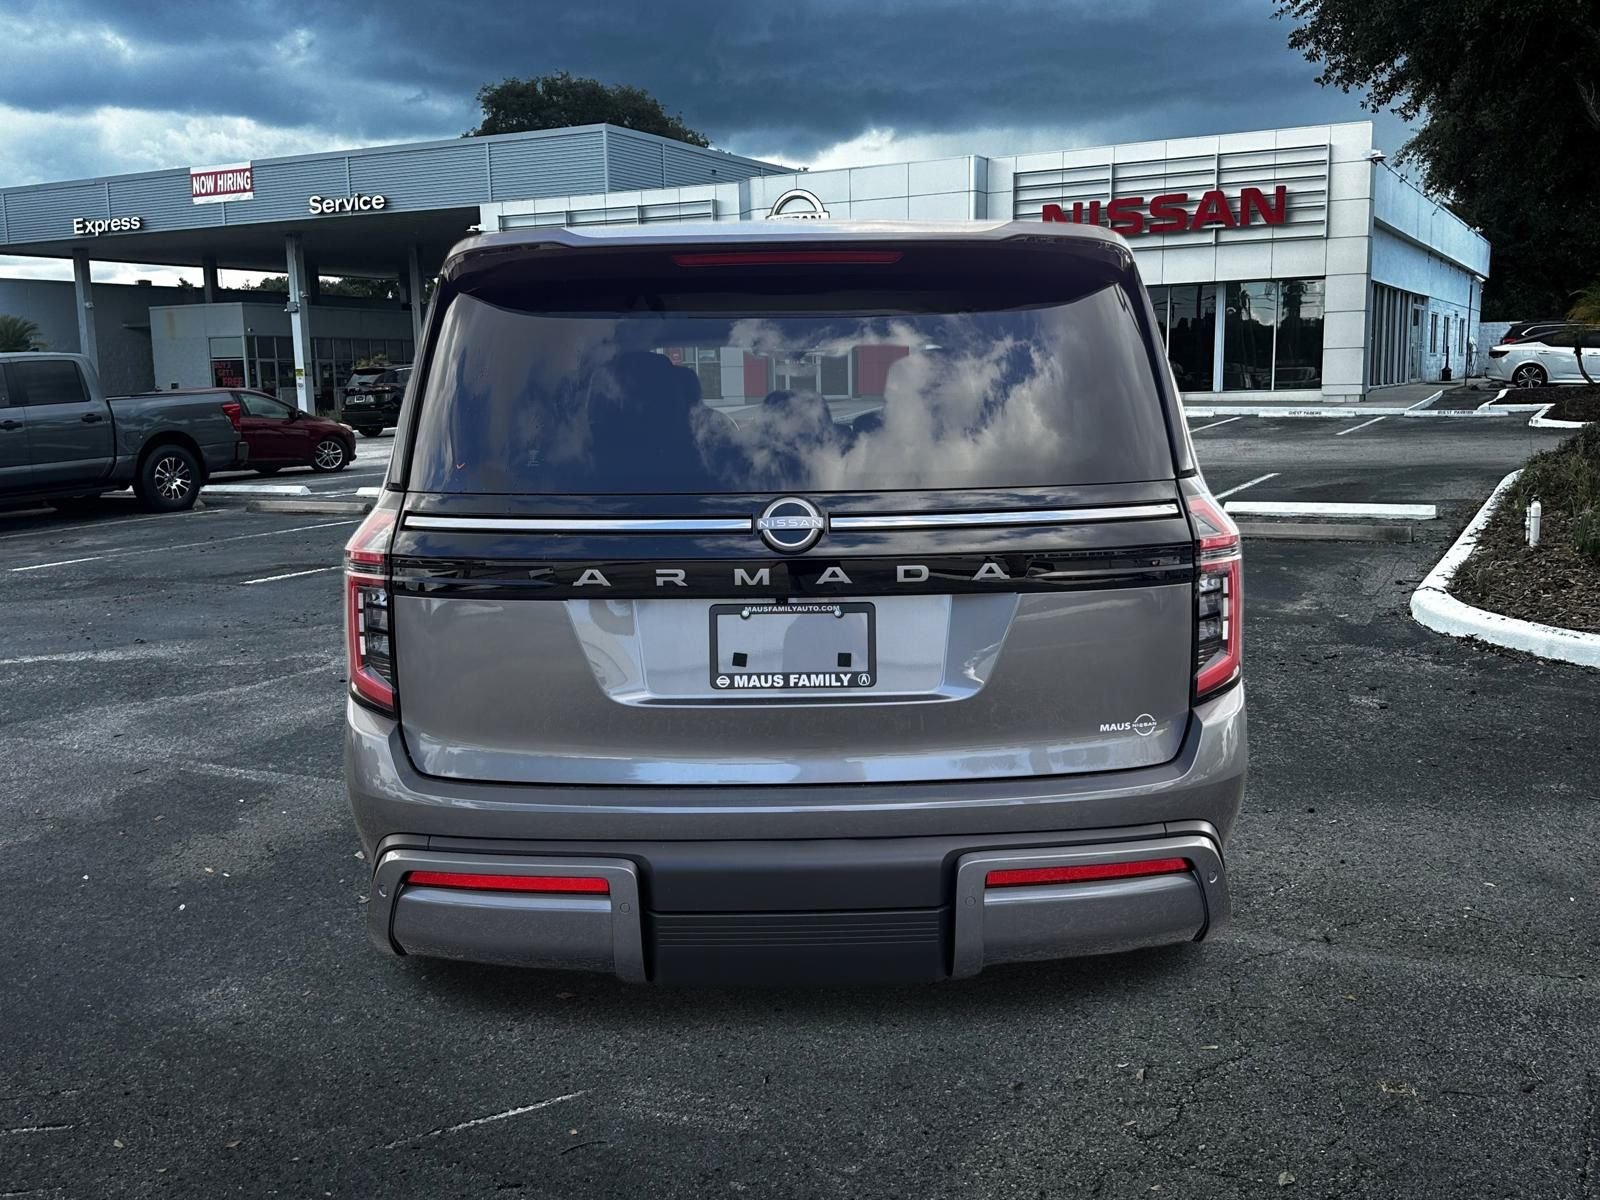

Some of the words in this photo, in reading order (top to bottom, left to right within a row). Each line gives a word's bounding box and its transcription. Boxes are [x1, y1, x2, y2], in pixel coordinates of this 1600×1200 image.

[192, 174, 215, 195] NOW
[217, 171, 251, 192] HIRING
[308, 193, 385, 214] Service
[73, 216, 141, 237] Express
[759, 519, 821, 528] NISSAN
[572, 562, 1010, 587] ARMADA
[745, 605, 841, 613] MAUSFAMILYAUTO.COM
[734, 674, 784, 688] MAUS
[789, 673, 852, 687] FAMILY
[1099, 722, 1131, 732] MAUS
